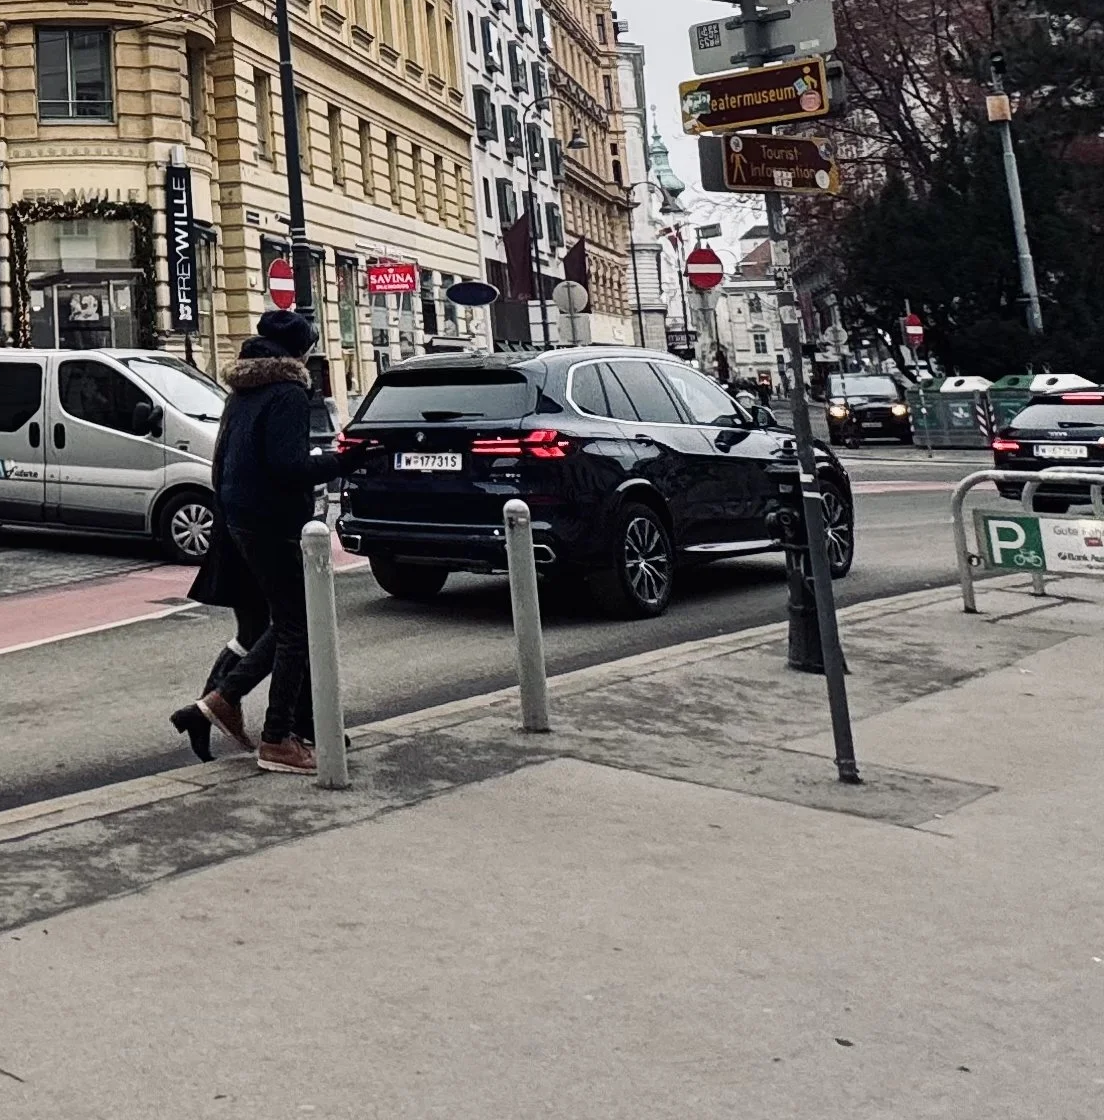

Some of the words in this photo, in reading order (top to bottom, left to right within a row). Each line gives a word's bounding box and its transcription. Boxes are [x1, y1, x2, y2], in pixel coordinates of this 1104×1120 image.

[711, 85, 796, 112] eatermuseum
[172, 176, 191, 304] FREYWILLE
[370, 273, 413, 284] SAVINA
[988, 520, 1026, 564] P
